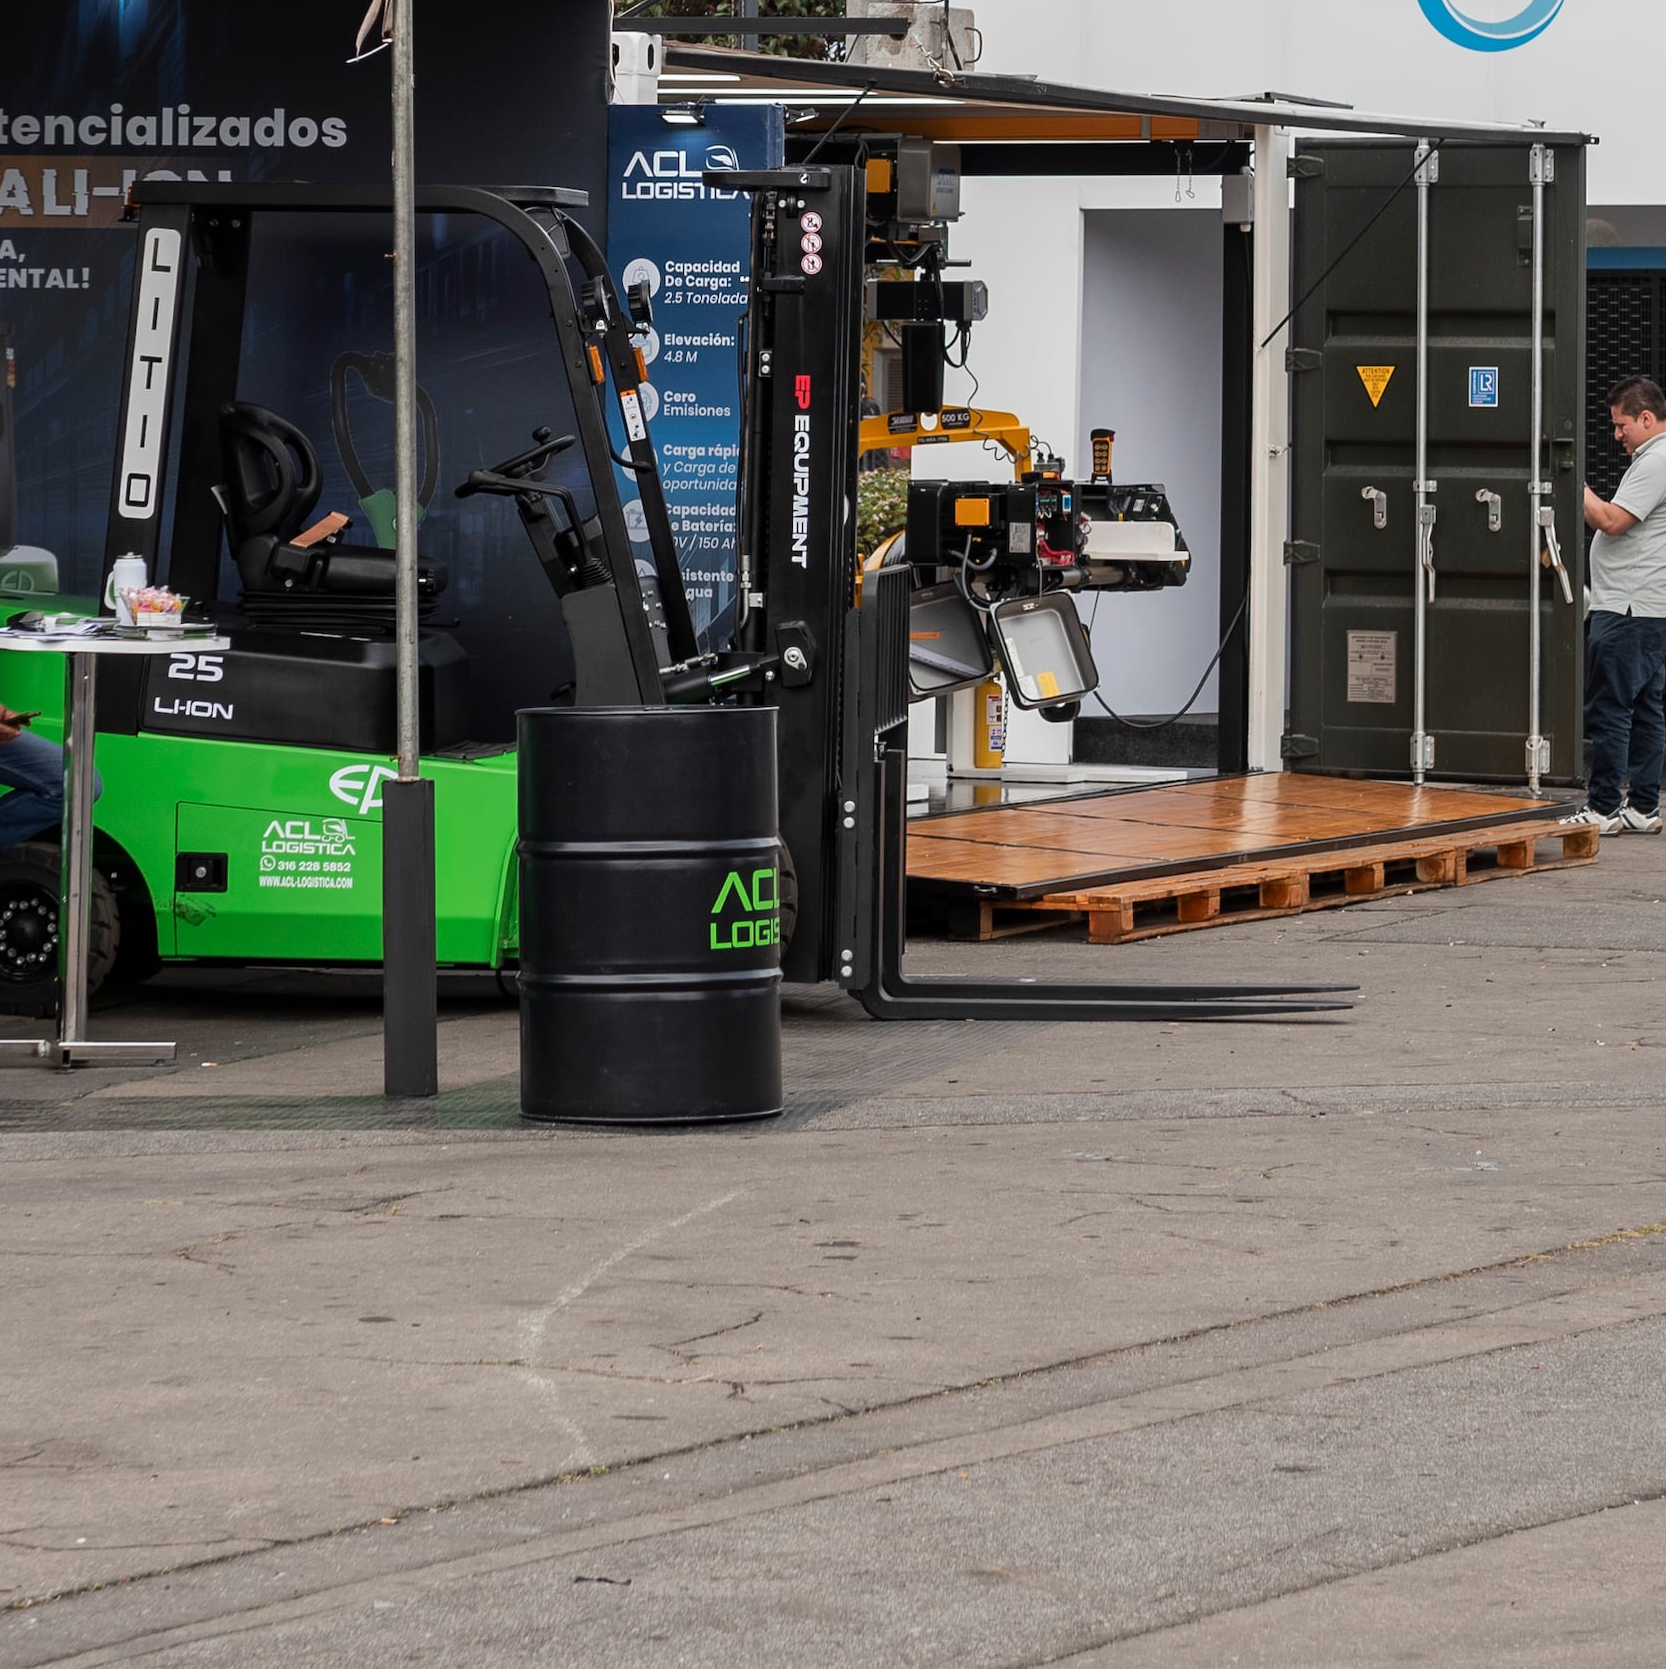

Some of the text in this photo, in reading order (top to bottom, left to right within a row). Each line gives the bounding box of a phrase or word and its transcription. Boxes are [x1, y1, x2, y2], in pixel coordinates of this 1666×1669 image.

[623, 151, 702, 177] ACL
[665, 260, 740, 276] Capacidad
[665, 276, 731, 291] De Carga:
[664, 292, 748, 304] 2.5 Tonelada
[664, 333, 735, 348] Elevación:
[664, 350, 698, 364] 4.8 M
[663, 389, 696, 404] Cero
[663, 404, 731, 417] Emisiones
[942, 413, 969, 422] 500 KG
[663, 443, 740, 460] Carga rápi
[663, 462, 736, 476] y Carga de
[791, 375, 811, 569] EP EQUIPMENT
[663, 478, 737, 493] oportunida
[682, 520, 736, 532] Batería:
[699, 537, 719, 548] 150
[681, 568, 734, 581] sistente
[685, 588, 712, 600] gua
[168, 653, 223, 682] 25
[263, 820, 321, 839] ACL
[262, 841, 356, 855] LOGISTICA
[277, 861, 351, 872] 316 228 5852
[259, 876, 353, 889] WWW.ACL-LOGISTICA.COM
